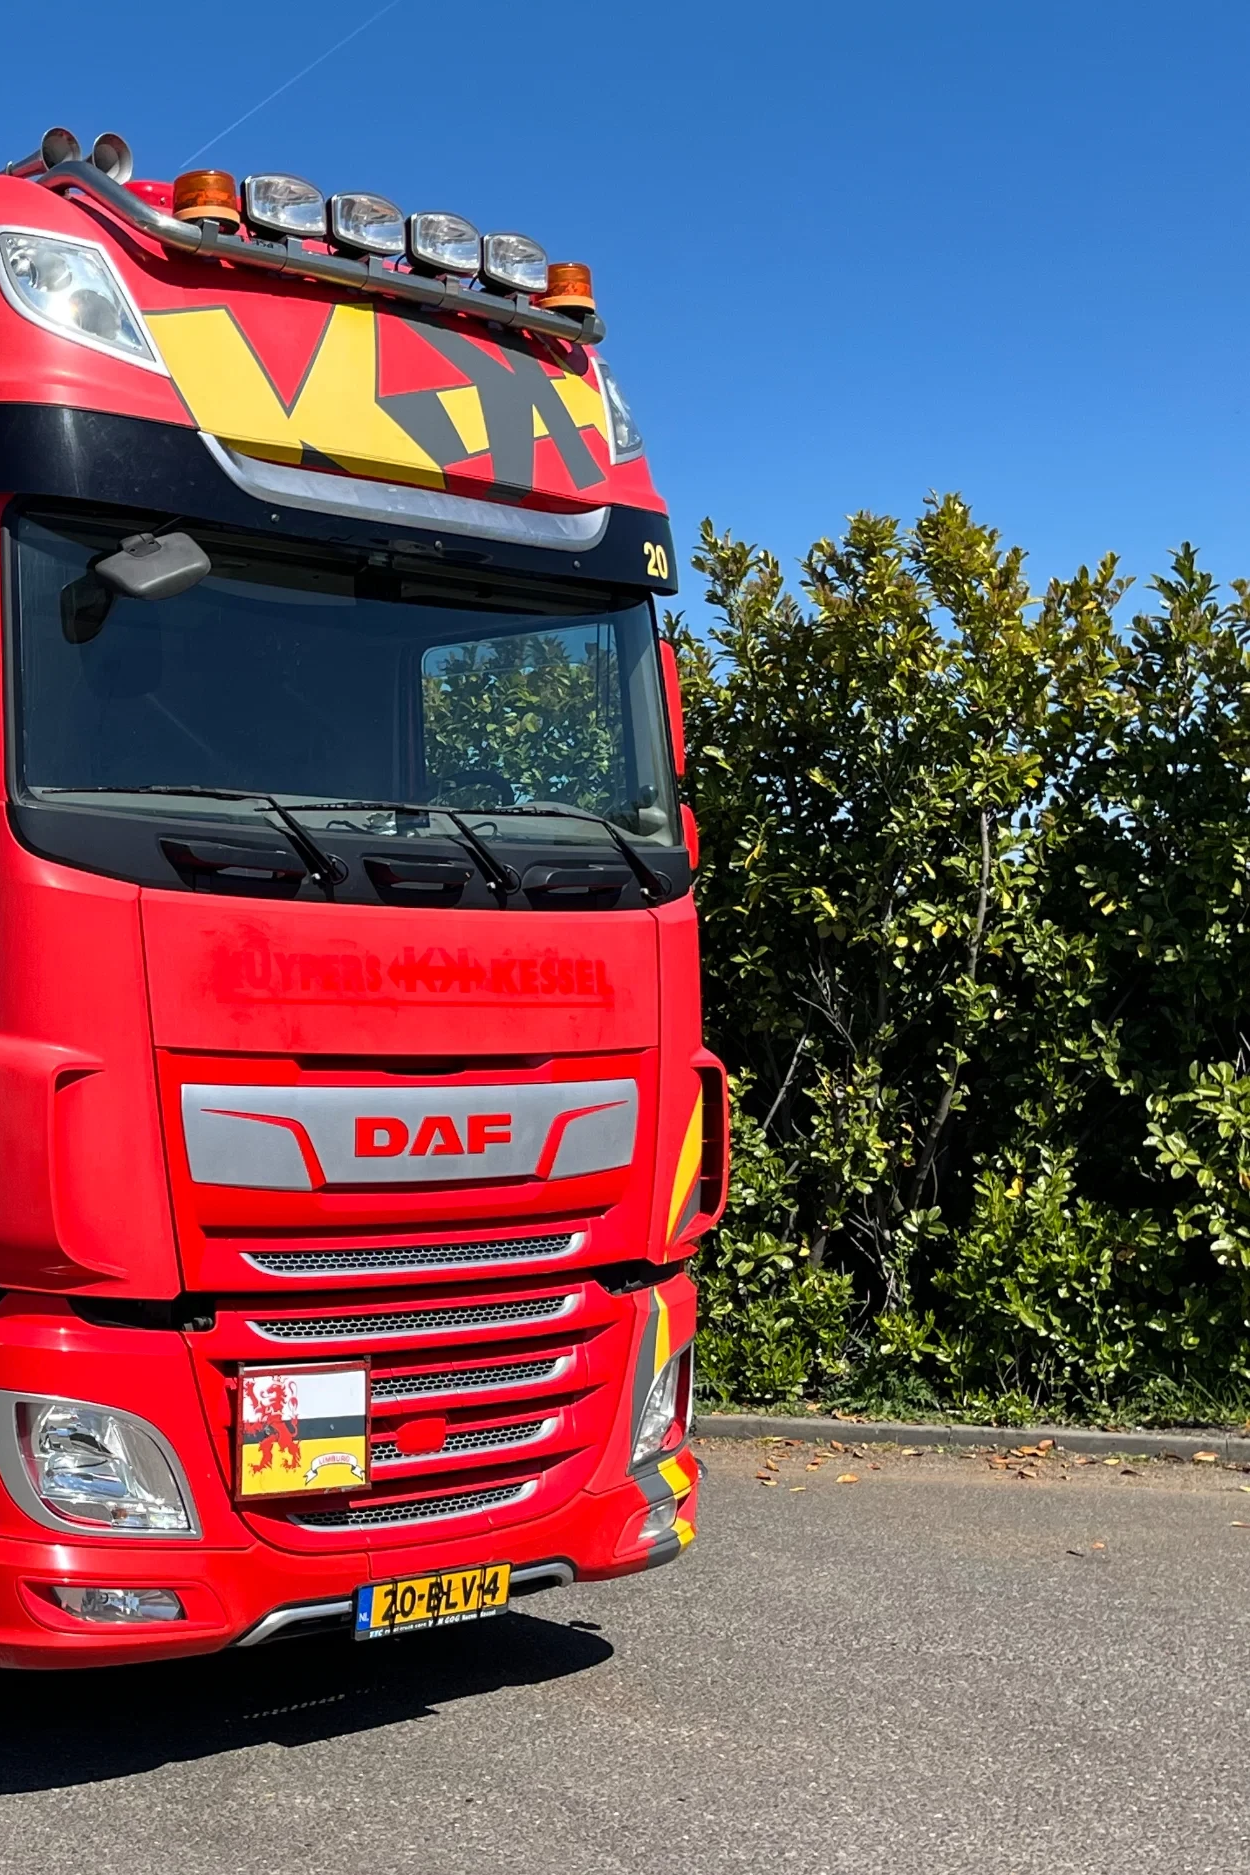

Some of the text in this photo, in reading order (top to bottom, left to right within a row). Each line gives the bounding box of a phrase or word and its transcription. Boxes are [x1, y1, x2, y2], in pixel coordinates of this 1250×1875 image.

[643, 541, 668, 580] 20
[490, 957, 614, 996] KESSEL
[355, 1113, 512, 1157] DAF
[318, 1454, 351, 1465] LIMBURG
[358, 1611, 370, 1623] NL
